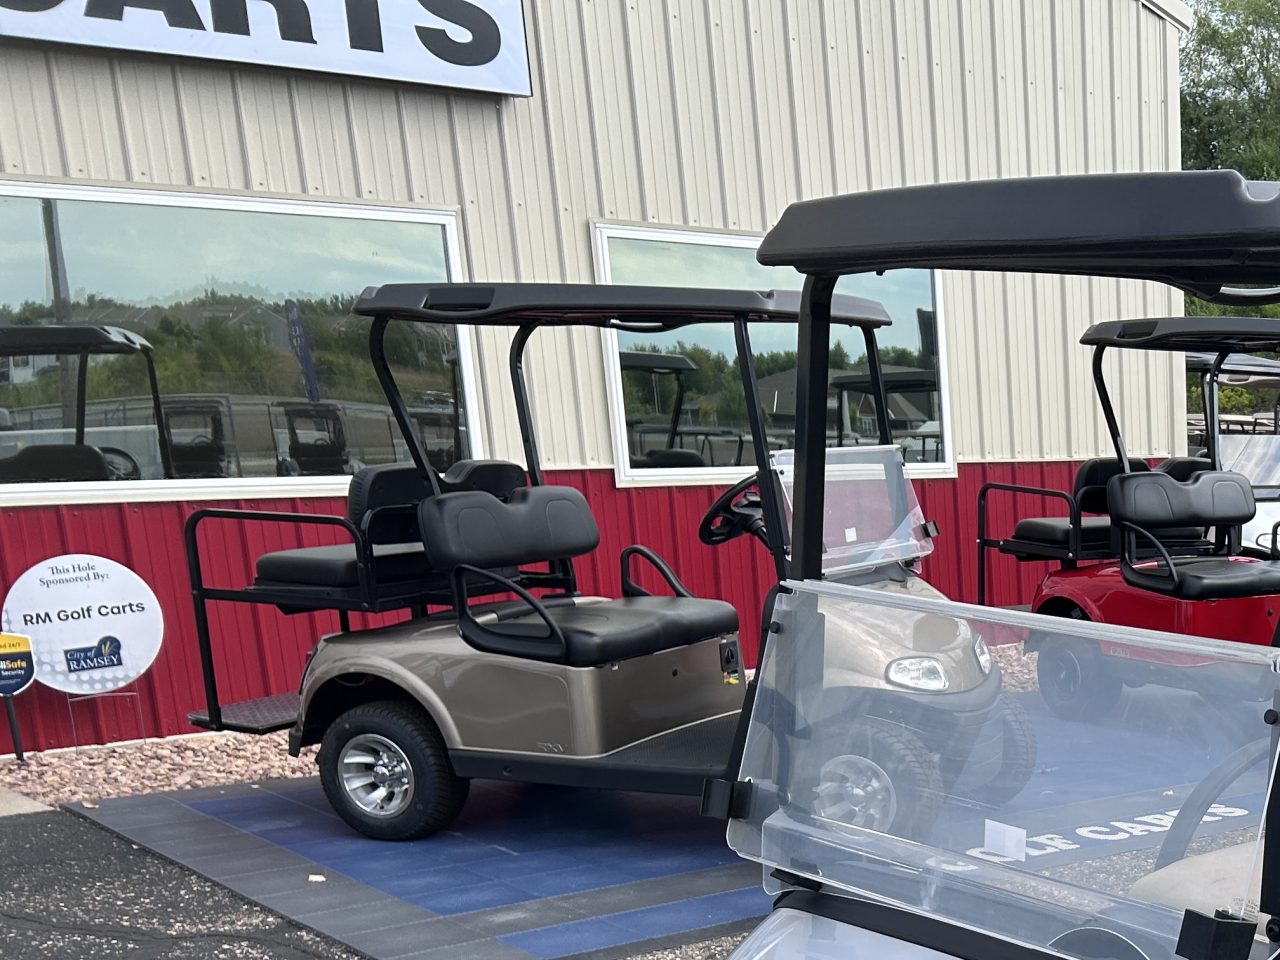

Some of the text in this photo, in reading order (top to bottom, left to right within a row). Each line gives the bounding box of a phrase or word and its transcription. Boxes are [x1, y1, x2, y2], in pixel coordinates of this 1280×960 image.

[48, 563, 96, 576] This Hole
[39, 572, 109, 588] Sponsored By:
[23, 602, 145, 626] RM Golf Carts
[67, 648, 97, 661] City of
[69, 655, 119, 671] RAMSEY
[1075, 803, 1249, 842] CARS
